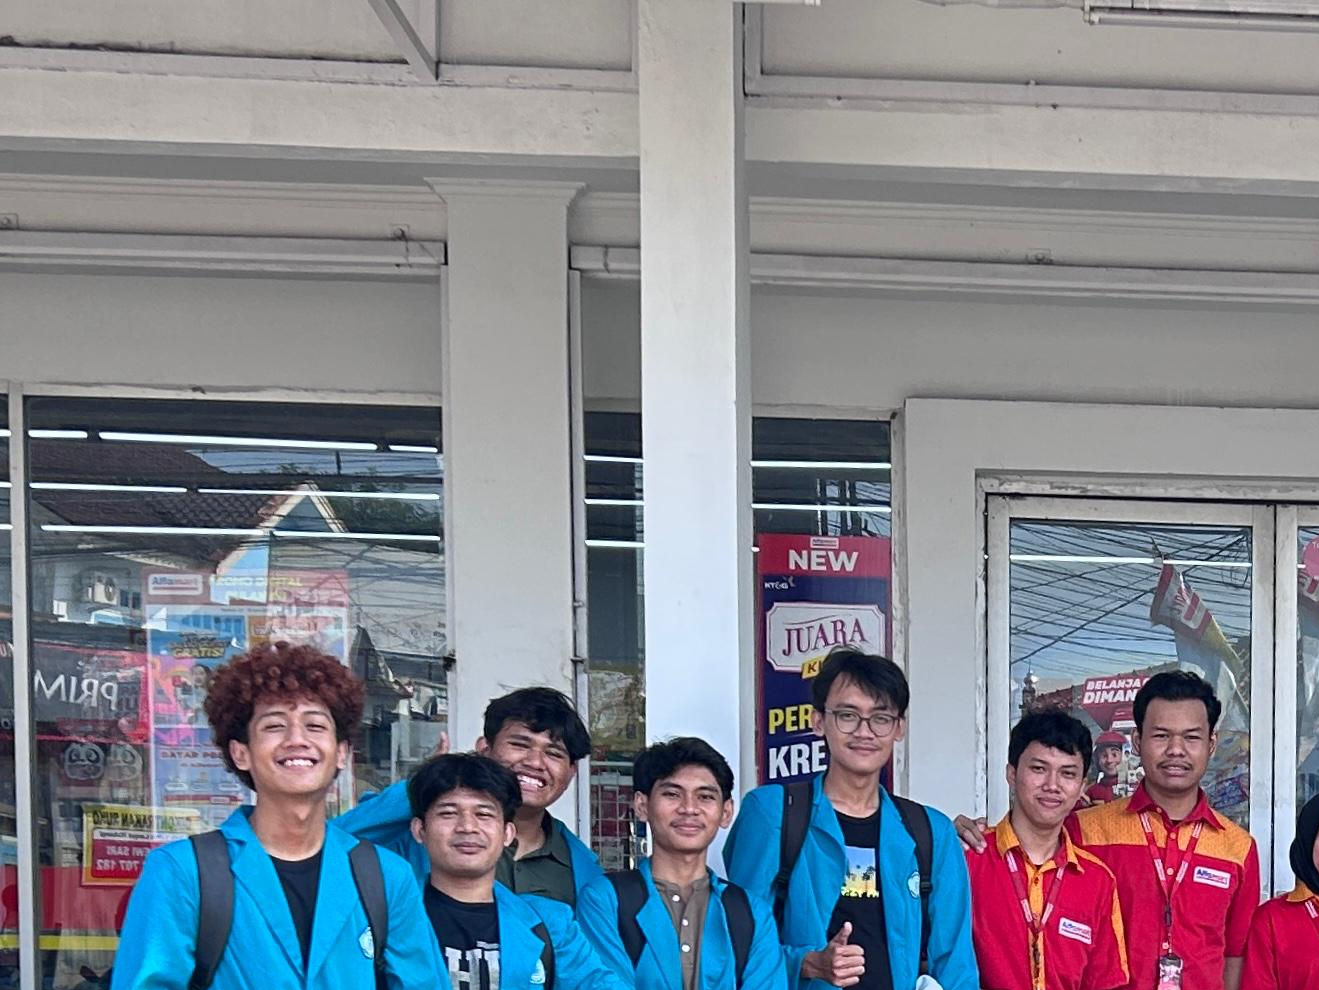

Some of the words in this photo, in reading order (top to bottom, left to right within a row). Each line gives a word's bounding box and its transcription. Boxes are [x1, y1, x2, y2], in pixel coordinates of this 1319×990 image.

[788, 549, 859, 572] NEW
[782, 618, 870, 657] JUARA
[1086, 679, 1141, 691] BELANJA
[1083, 689, 1138, 705] DIMAN
[768, 740, 828, 779] KRE
